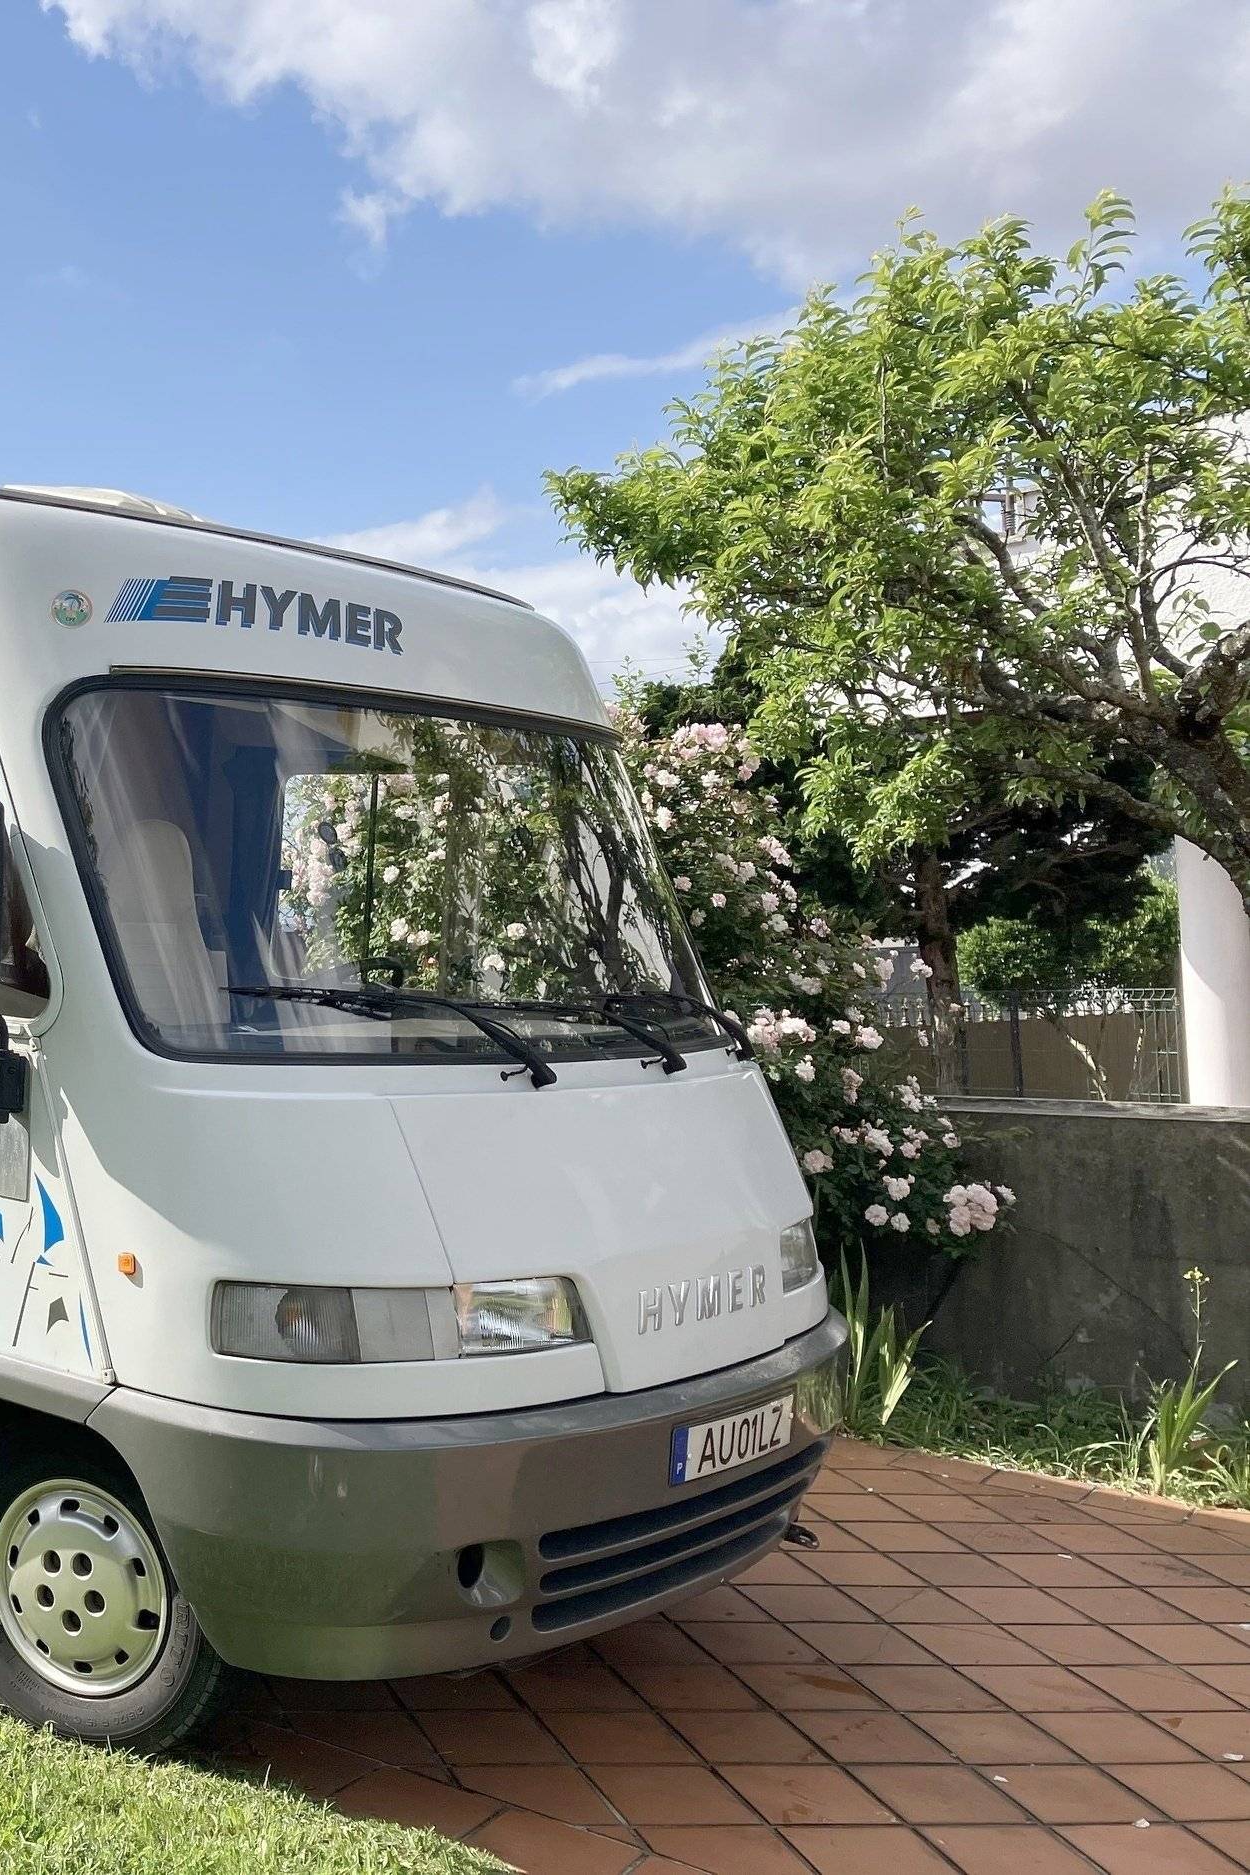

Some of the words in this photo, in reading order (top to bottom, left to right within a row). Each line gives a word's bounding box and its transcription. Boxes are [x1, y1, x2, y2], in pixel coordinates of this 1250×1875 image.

[637, 1264, 766, 1335] HYMER
[676, 1462, 683, 1475] P
[697, 1404, 784, 1474] AU01LZ
